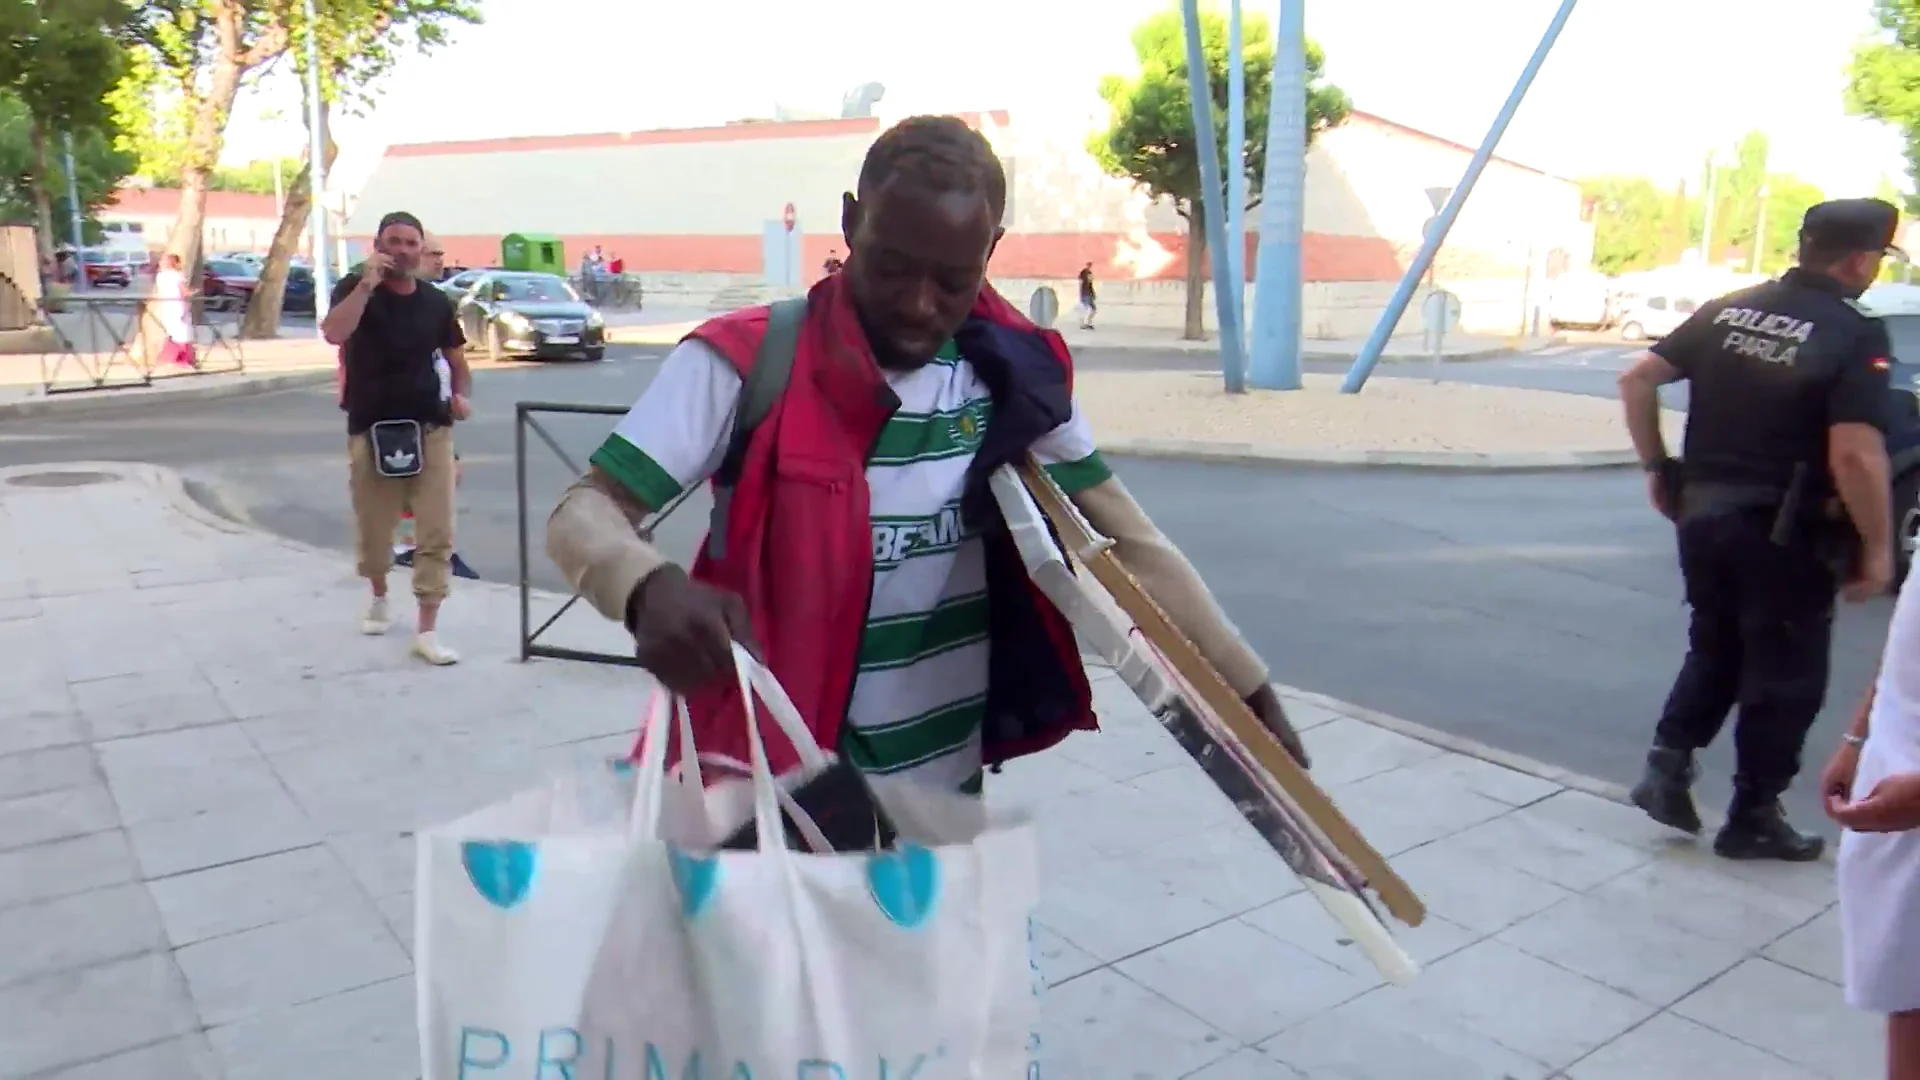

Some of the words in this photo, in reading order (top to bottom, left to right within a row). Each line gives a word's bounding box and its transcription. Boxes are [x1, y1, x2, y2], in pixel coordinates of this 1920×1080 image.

[1712, 307, 1815, 343] POLICIA
[1722, 331, 1799, 366] PARLA
[457, 1026, 930, 1080] PRIM
